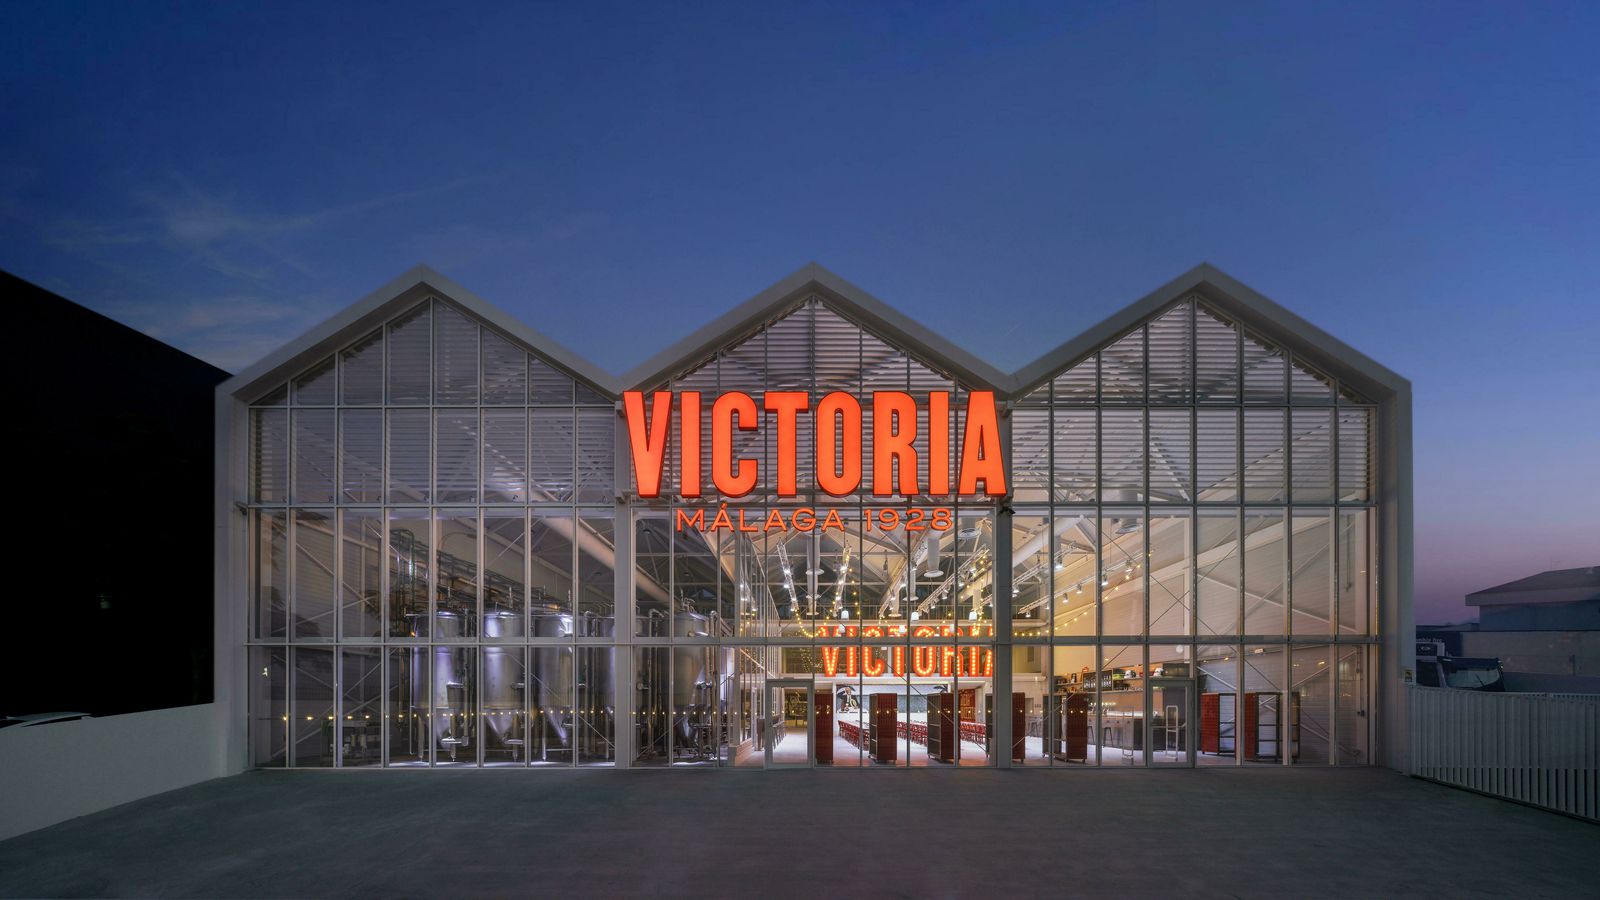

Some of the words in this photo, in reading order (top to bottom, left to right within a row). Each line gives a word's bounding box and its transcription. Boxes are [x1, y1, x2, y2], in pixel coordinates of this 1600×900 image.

[623, 391, 1007, 498] VICTORIA
[676, 503, 846, 533] MÁLAGA
[865, 507, 954, 532] 1928
